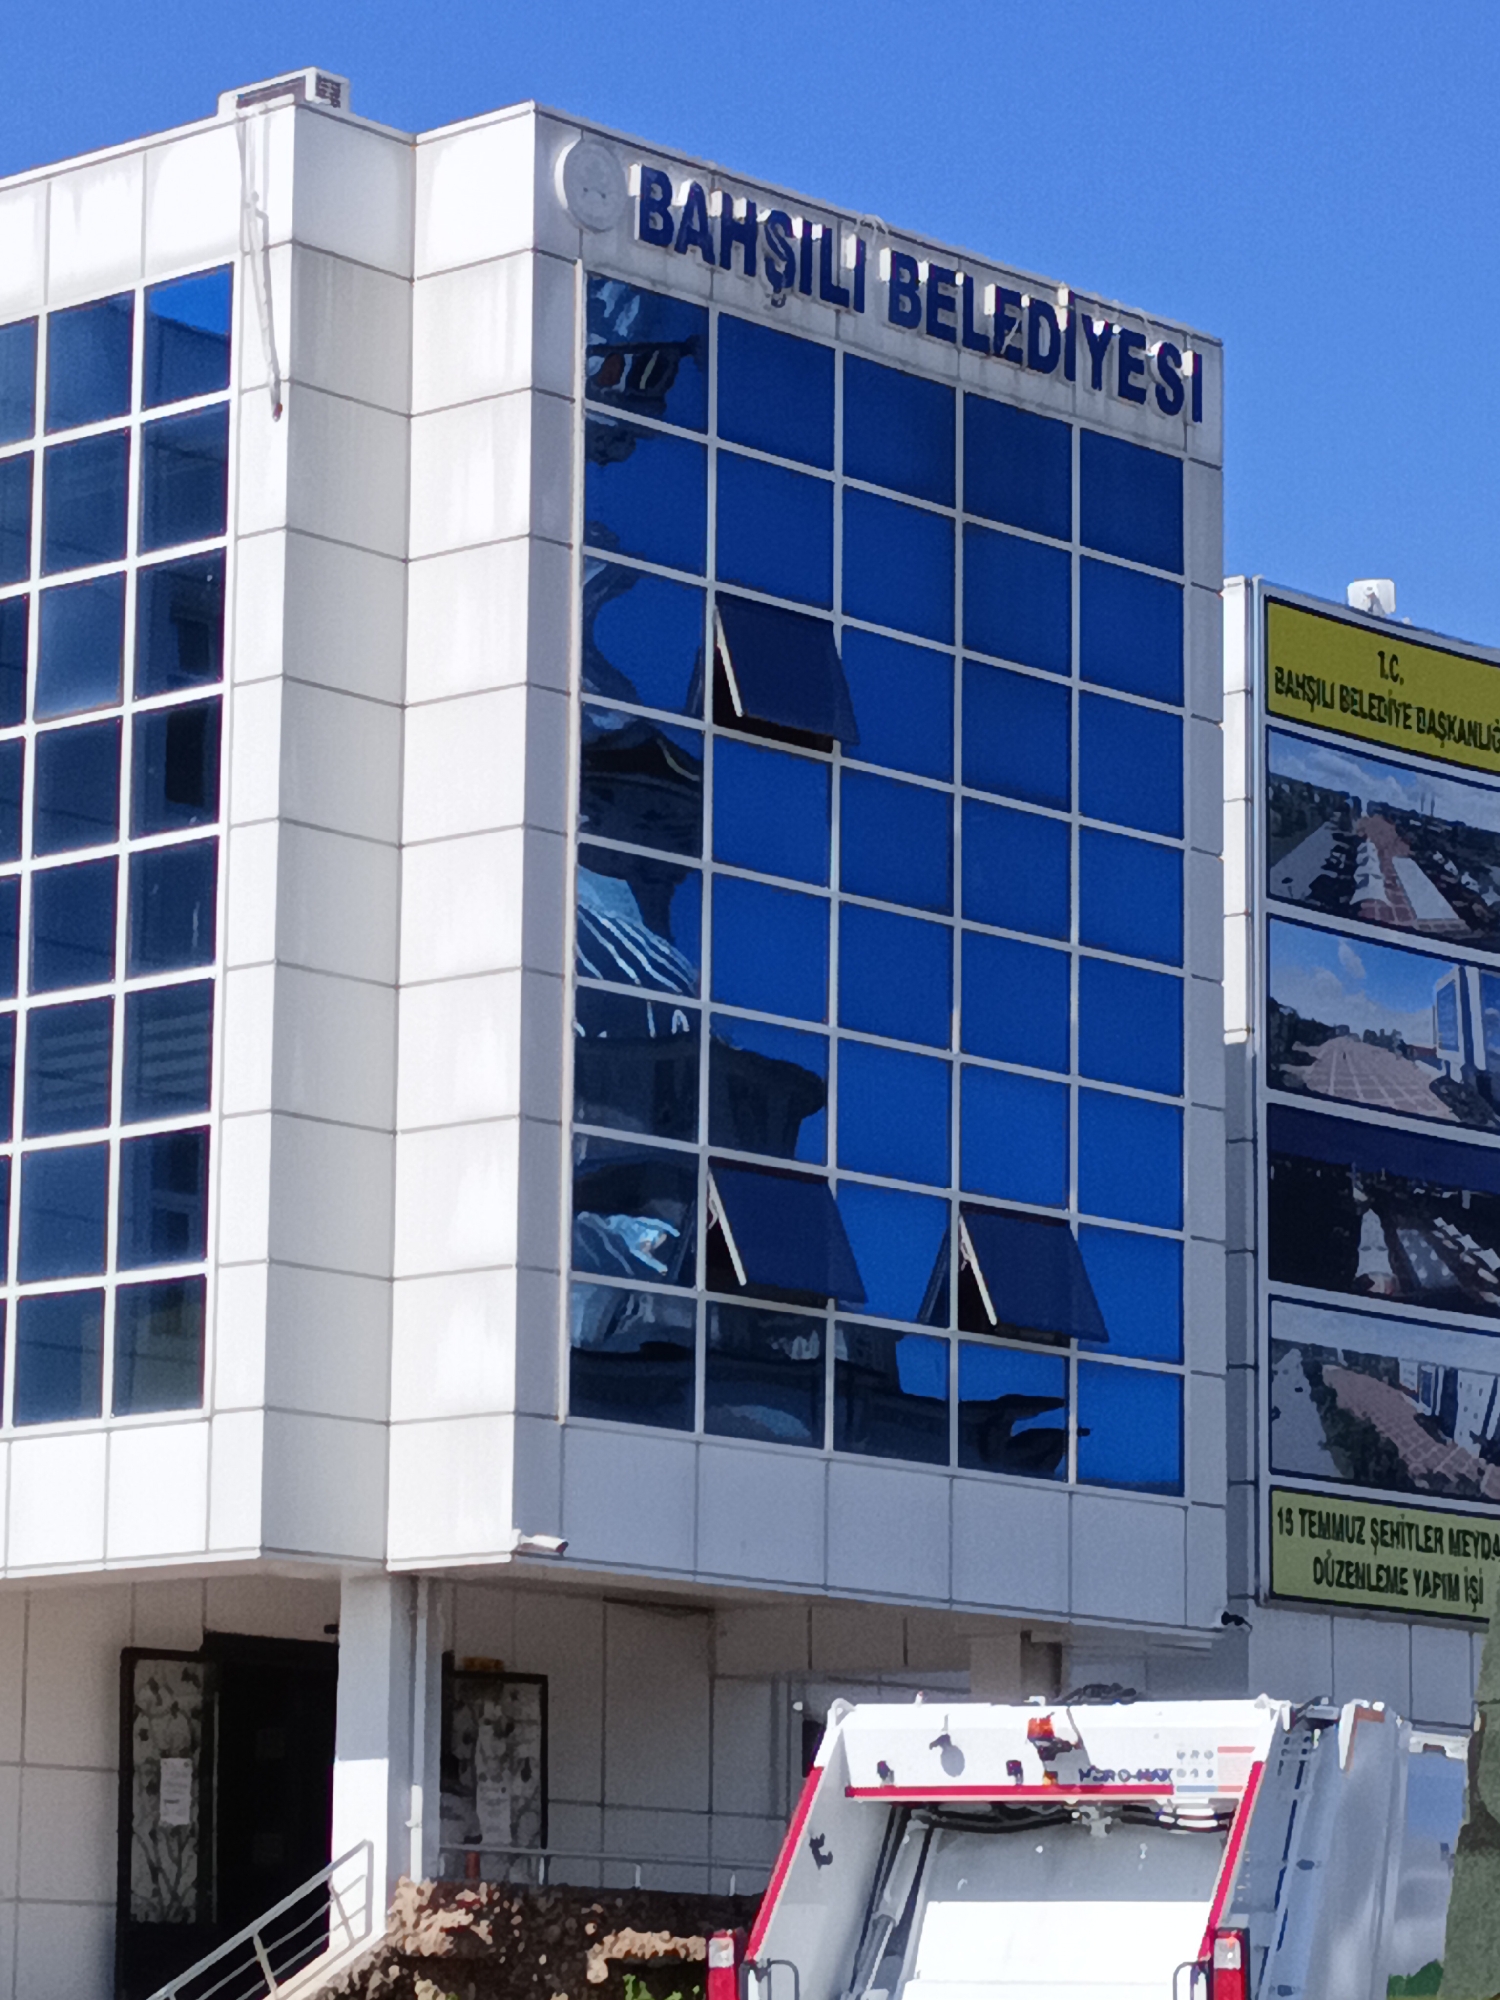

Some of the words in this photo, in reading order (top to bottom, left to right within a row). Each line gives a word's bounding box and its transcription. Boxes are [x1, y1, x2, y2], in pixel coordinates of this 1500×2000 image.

[1274, 665, 1335, 713] BAHŞILI
[1339, 688, 1412, 731] BELEDİYE
[1298, 1507, 1366, 1546] TEMMUZ
[1370, 1513, 1444, 1556] ŞEHİTLER
[1313, 1549, 1409, 1596] DÜZENLEME
